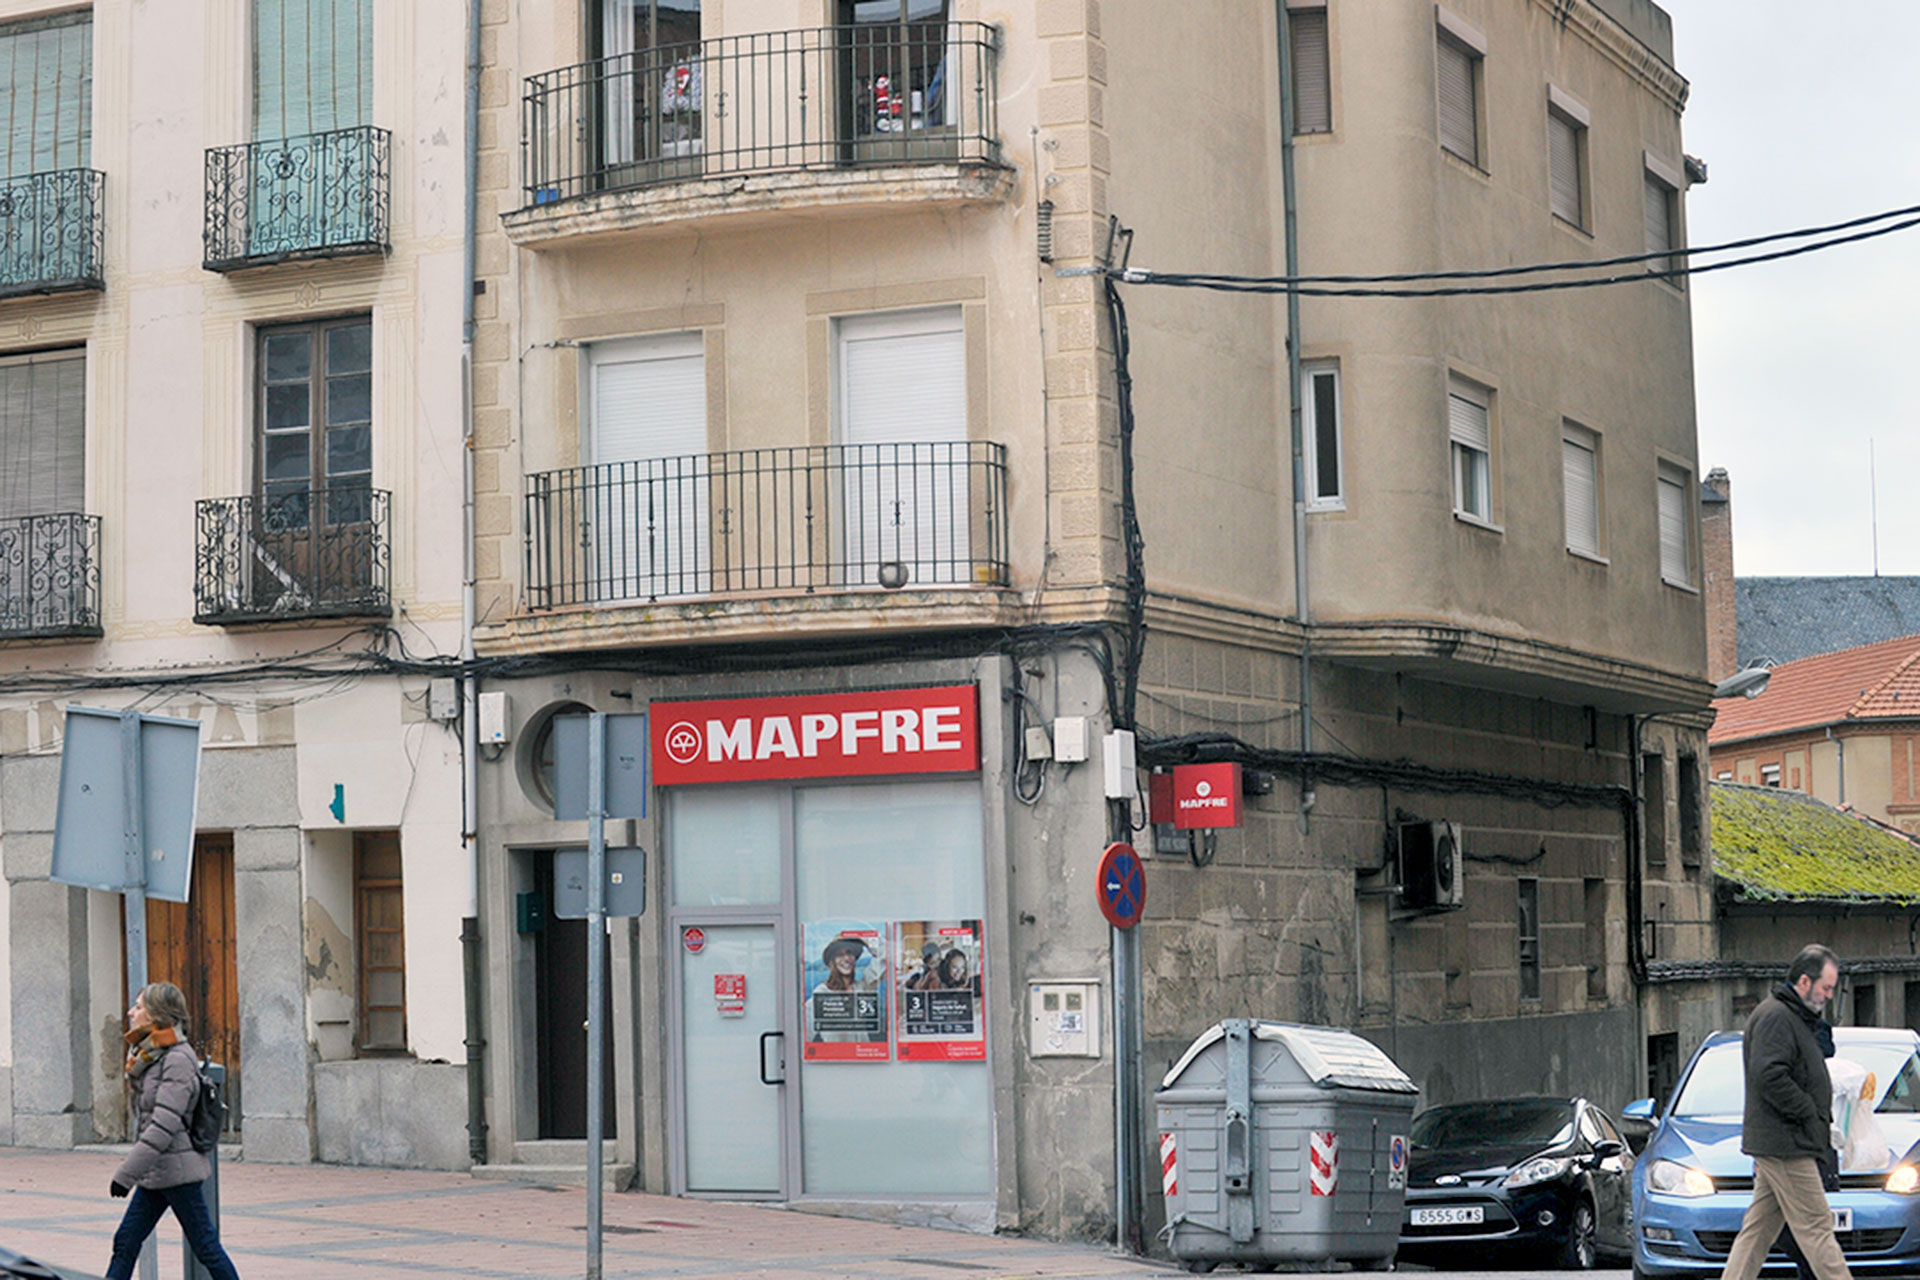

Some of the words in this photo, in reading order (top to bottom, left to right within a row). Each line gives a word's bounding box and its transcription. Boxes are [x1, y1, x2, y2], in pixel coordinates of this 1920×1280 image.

[706, 706, 961, 762] MAPFRE
[1180, 797, 1228, 808] MAPFRE
[912, 996, 920, 1009] 3
